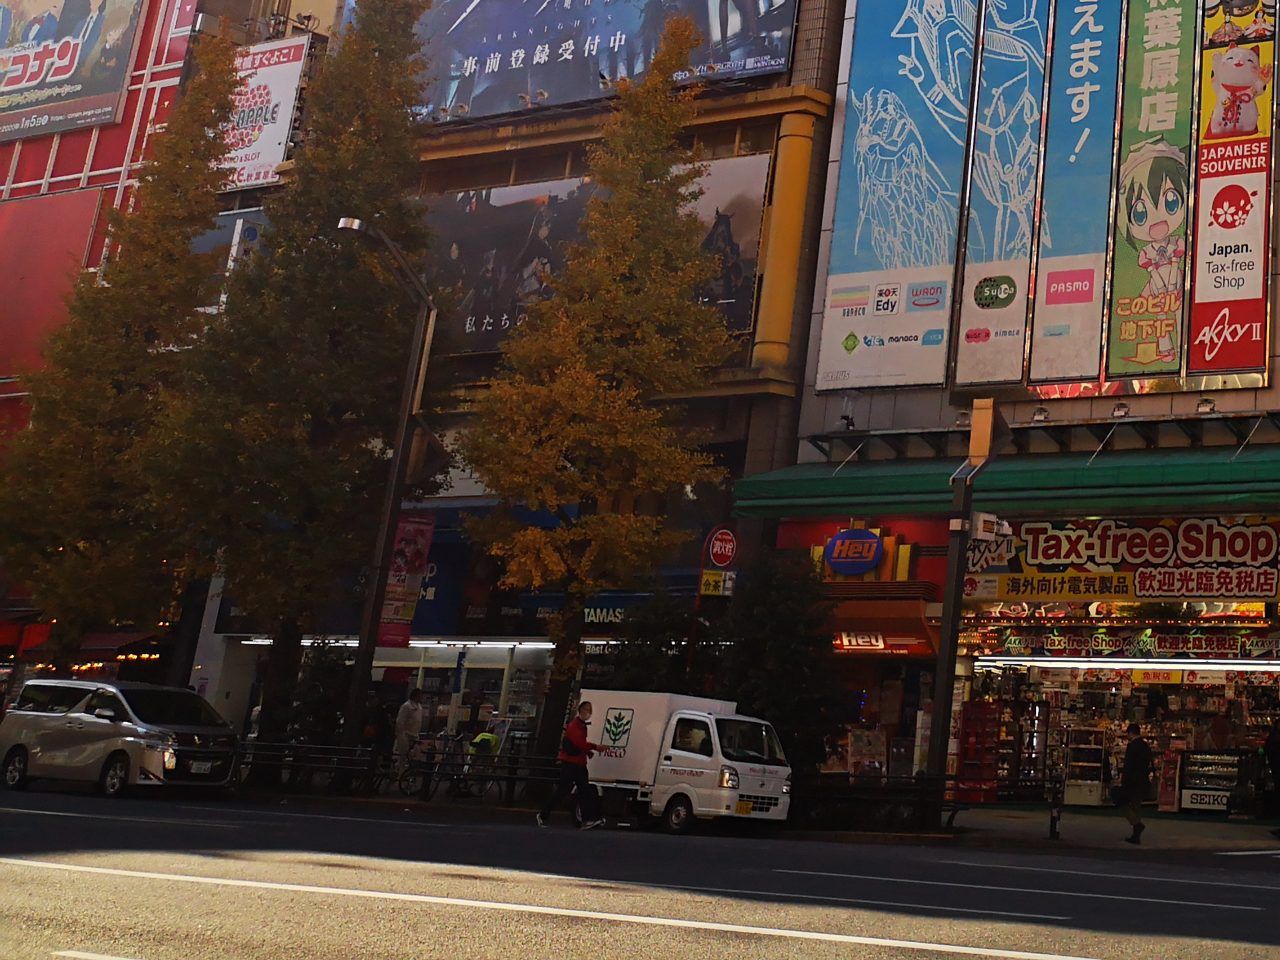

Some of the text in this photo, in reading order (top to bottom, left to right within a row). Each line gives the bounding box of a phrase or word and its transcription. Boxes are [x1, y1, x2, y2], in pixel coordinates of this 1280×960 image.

[0, 38, 79, 88] コナン
[461, 31, 626, 77] 事前登録受付中
[1201, 142, 1268, 161] JAPANESE
[1200, 156, 1267, 175] SOUVENIR
[1209, 241, 1253, 259] Japan.
[1206, 258, 1255, 274] Tax-free
[984, 284, 1015, 298] Suica
[1050, 281, 1090, 294] PASMO
[1213, 275, 1245, 290] Shop
[875, 299, 897, 312] Edy
[1116, 292, 1182, 317] このビル
[1119, 318, 1175, 341] 地下1F
[832, 540, 878, 560] Hey
[1023, 521, 1275, 561] Tax-free Shop
[1006, 576, 1129, 596] 海外向け電気製品
[841, 631, 885, 649] Hey
[1044, 636, 1090, 649] Tax-free
[1092, 635, 1122, 650] Shop
[1190, 793, 1229, 806] SEIKO
